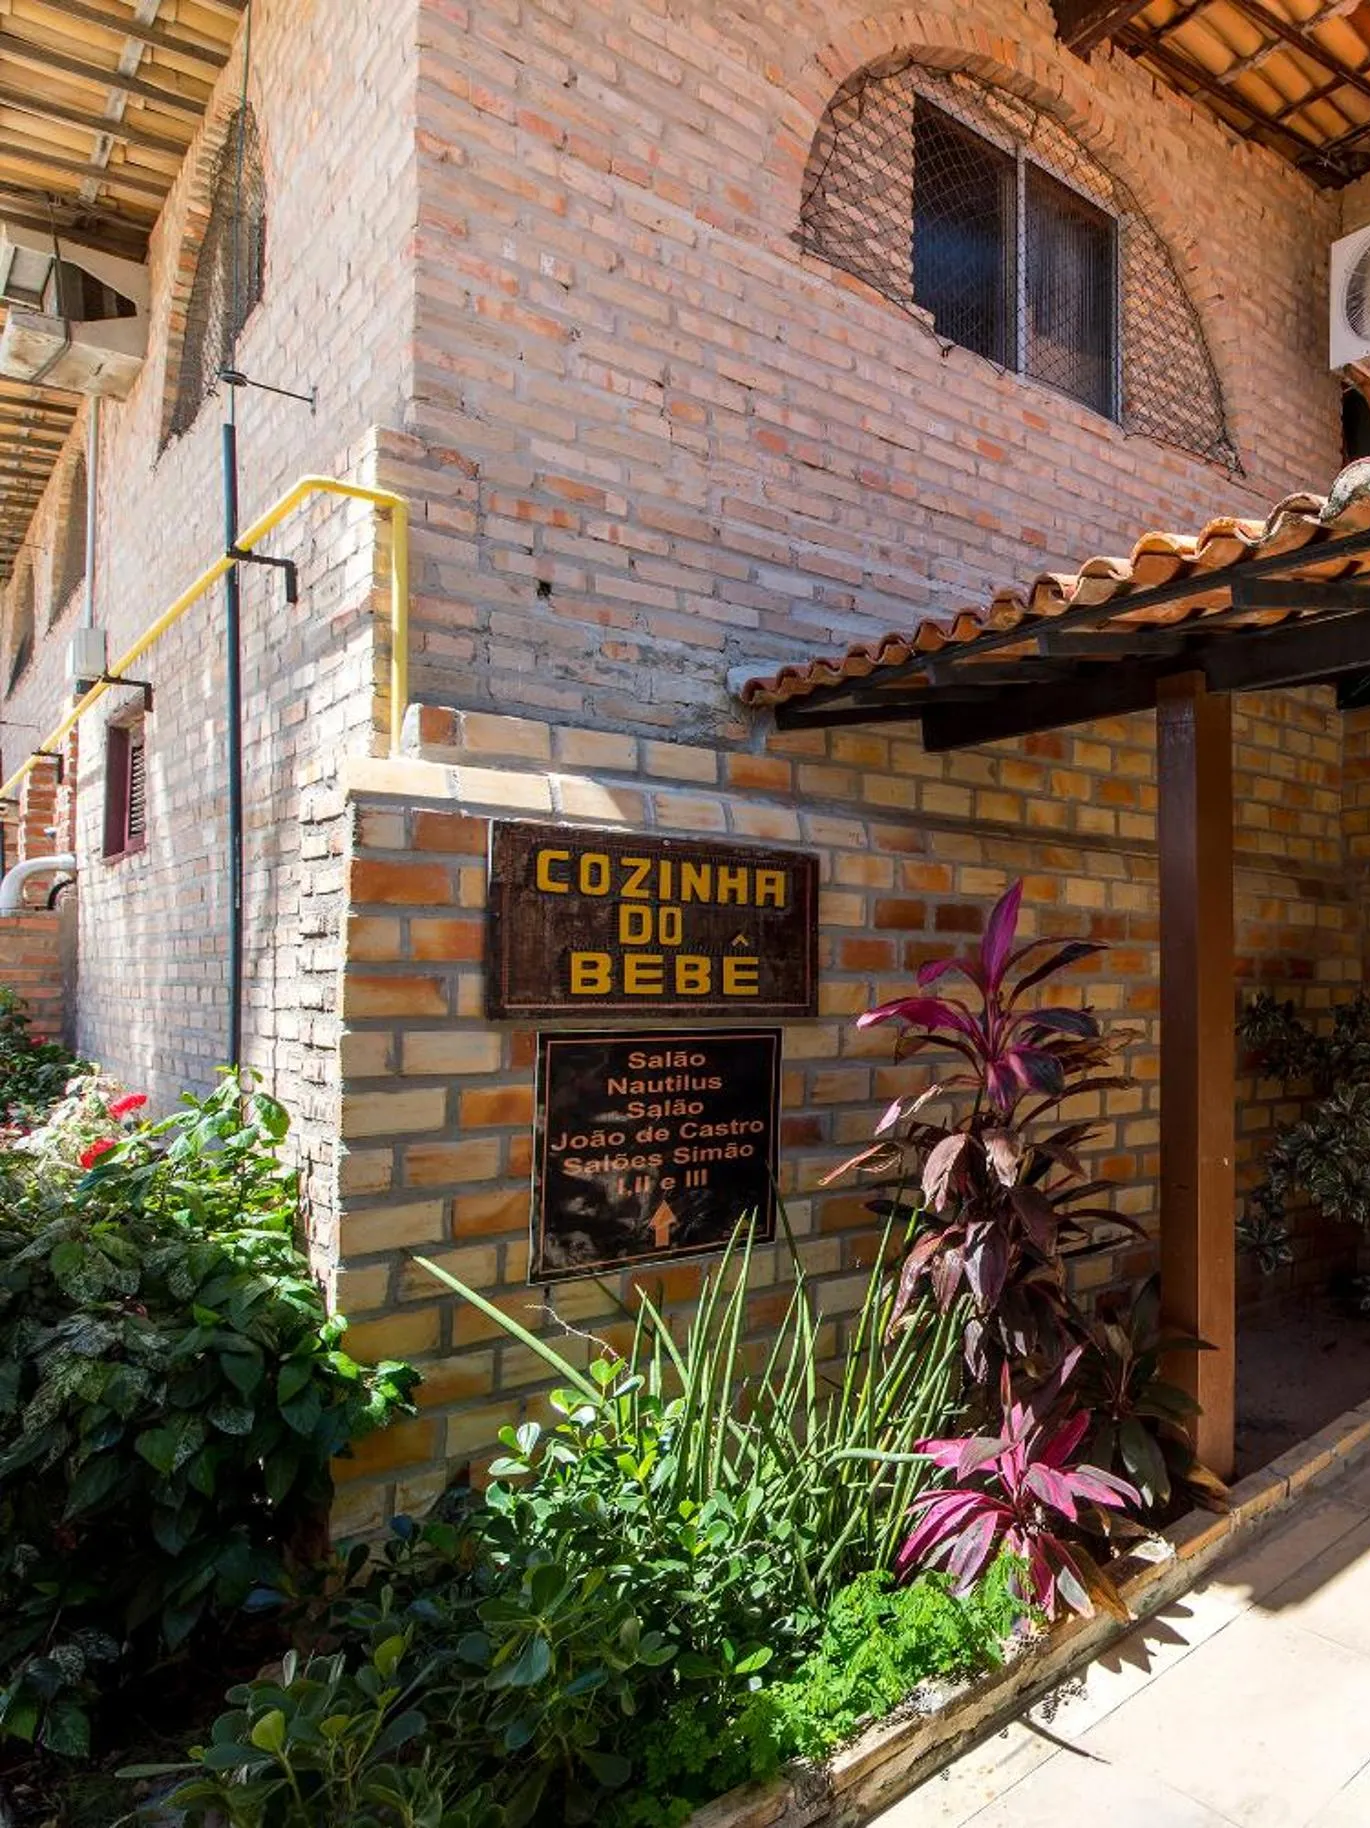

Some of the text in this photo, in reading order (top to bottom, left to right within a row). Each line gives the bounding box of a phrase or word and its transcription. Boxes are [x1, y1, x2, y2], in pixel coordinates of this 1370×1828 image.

[536, 849, 786, 908] COZINHA
[619, 904, 683, 946] DO
[570, 933, 760, 995] BEBÊ
[628, 1051, 706, 1070] Salão
[607, 1074, 723, 1096] Nautilus
[626, 1099, 704, 1119] Salão
[551, 1119, 764, 1151] João de Castro
[563, 1142, 754, 1176] Salões Simão
[661, 1177, 676, 1190] e
[685, 1168, 708, 1187] III
